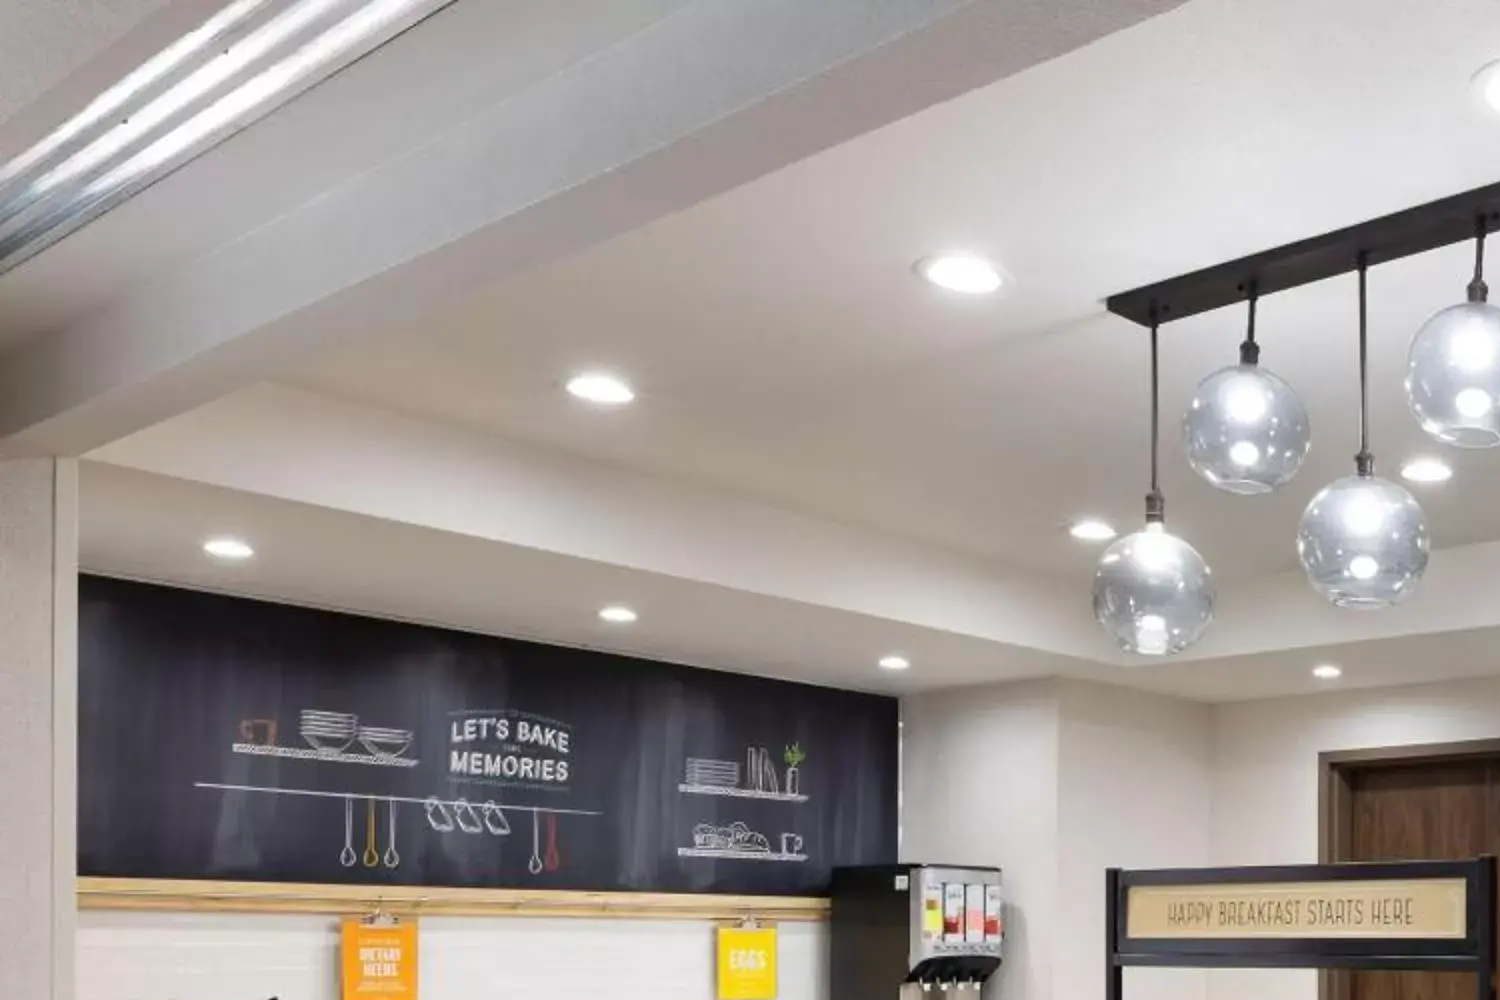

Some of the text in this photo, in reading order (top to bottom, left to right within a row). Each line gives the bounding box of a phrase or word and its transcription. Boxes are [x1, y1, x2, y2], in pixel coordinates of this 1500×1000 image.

[451, 717, 569, 753] LET'S BAKE
[450, 751, 568, 782] MEMORIES
[1167, 898, 1414, 926] HAPPY BREAKFAST STARTS HERE
